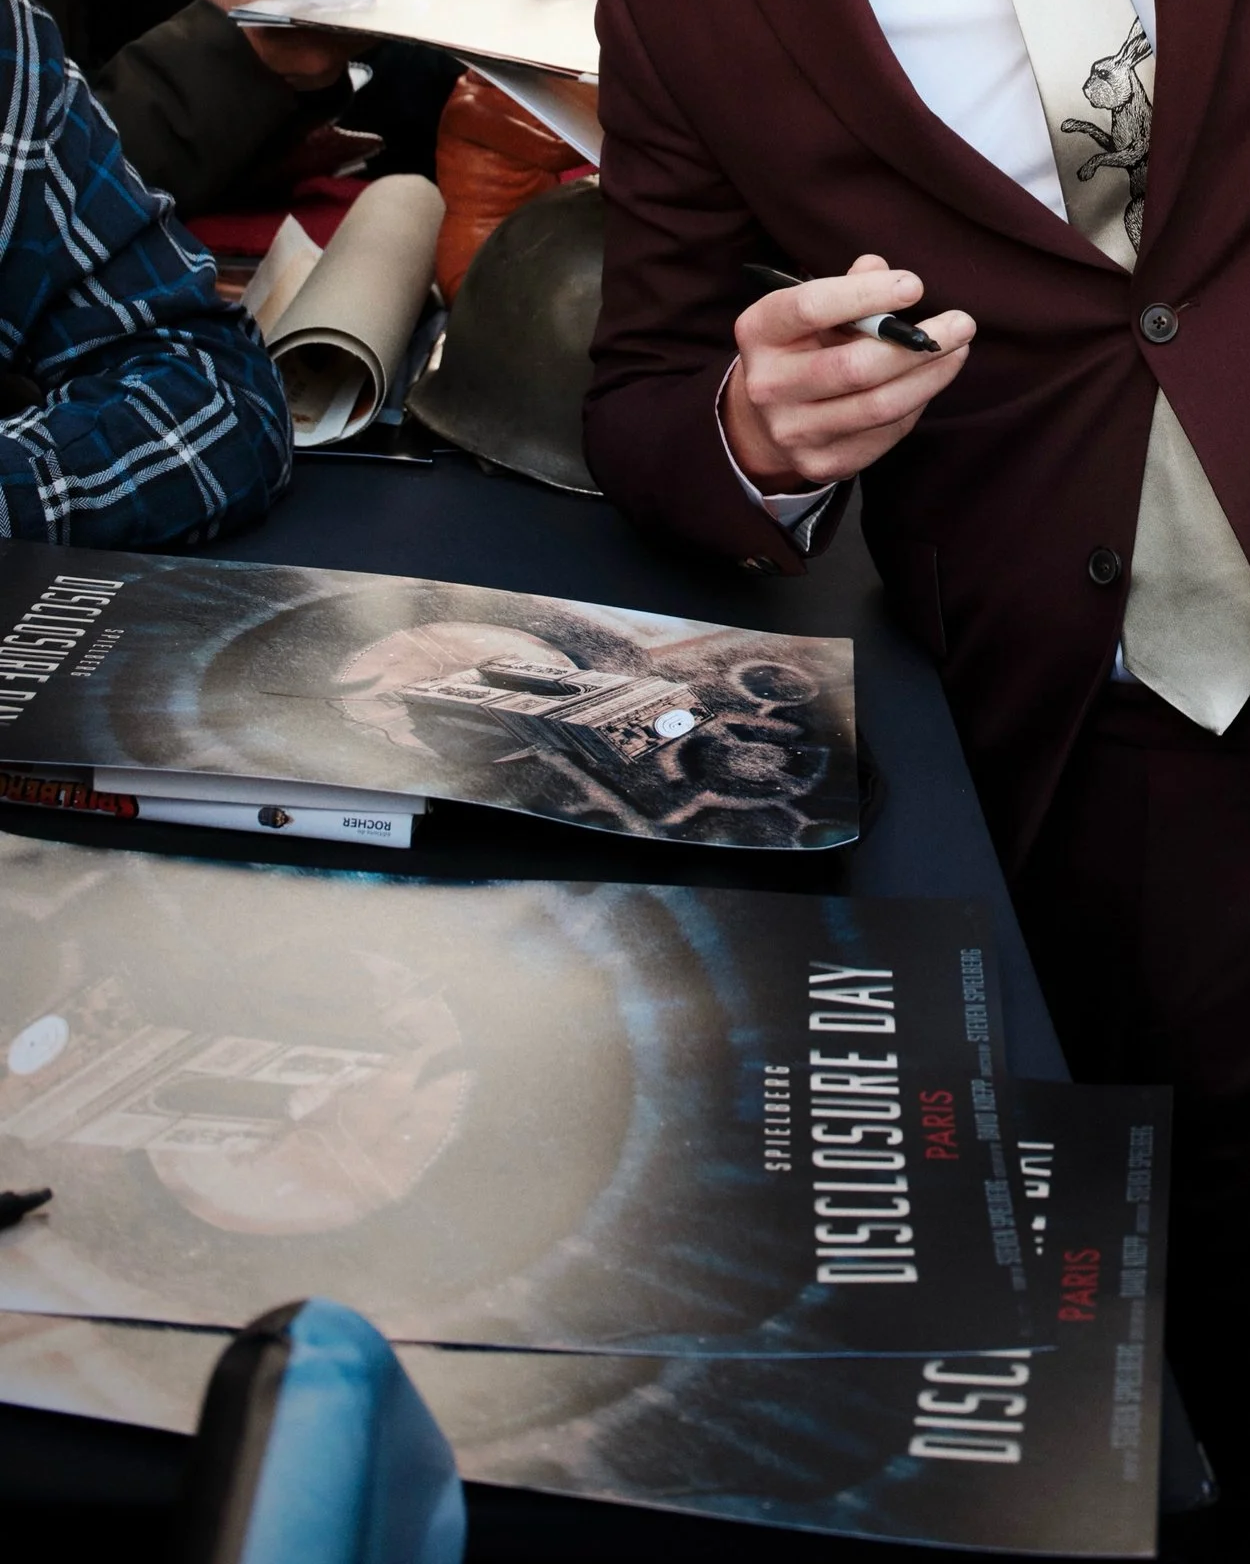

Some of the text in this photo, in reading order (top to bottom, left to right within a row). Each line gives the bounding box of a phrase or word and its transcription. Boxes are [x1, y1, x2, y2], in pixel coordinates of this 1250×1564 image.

[70, 628, 125, 677] SPIELBERG
[343, 816, 392, 832] ROCHER
[959, 948, 987, 1002] SPIELBERG
[965, 1003, 990, 1042] STEVEN
[764, 1065, 792, 1172] SPIELBERG
[808, 960, 919, 1283] DISCLOSURE DAY
[918, 1089, 960, 1161] PARIS
[1057, 1247, 1102, 1322] PARIS
[907, 1349, 1032, 1464] DISC
